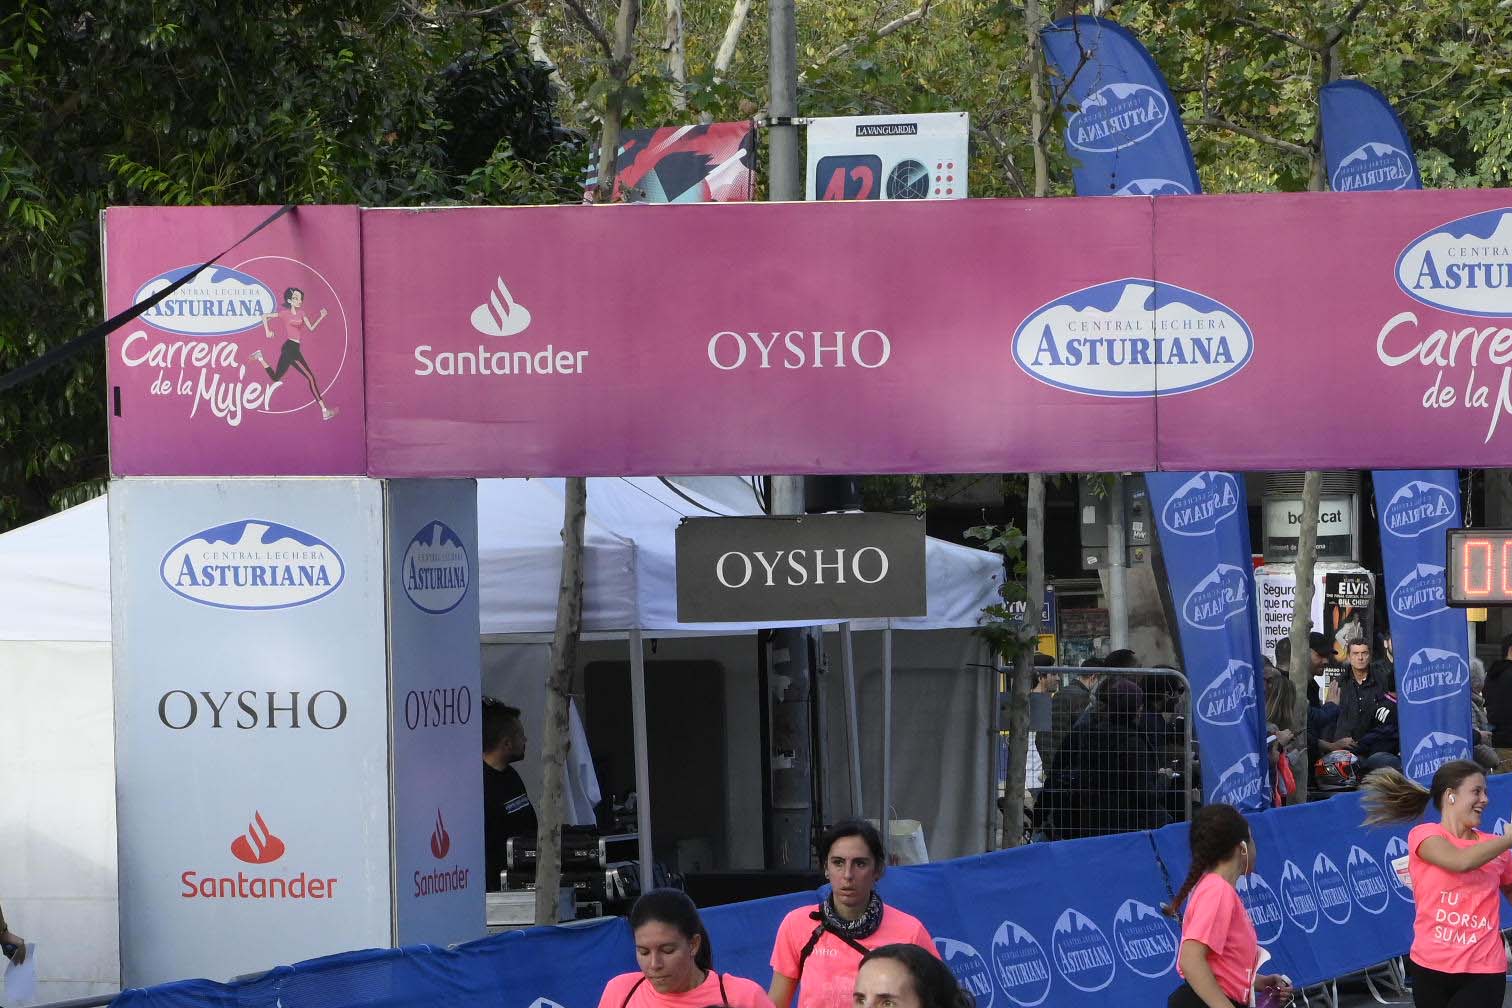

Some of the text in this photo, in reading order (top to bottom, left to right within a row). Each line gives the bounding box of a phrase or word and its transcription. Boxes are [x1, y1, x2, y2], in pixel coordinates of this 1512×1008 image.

[144, 290, 264, 317] ASTURIANA
[1069, 319, 1227, 331] CENTRAL LECHERA
[121, 331, 239, 368] Carrera
[415, 345, 589, 376] Santander
[707, 329, 891, 370] OYSHO
[1031, 324, 1235, 367] ASTURIANA
[150, 364, 283, 426] de la Mujer
[1422, 370, 1457, 409] de
[1464, 369, 1489, 409] la
[1288, 510, 1342, 525] b.cat
[175, 553, 331, 587] ASTURIANA
[203, 551, 325, 561] CENTRAL LECHERA
[716, 546, 889, 588] OYSHO
[407, 556, 466, 590] ASTURIANA
[1338, 582, 1369, 595] ELVIS
[1264, 600, 1279, 611] que
[158, 690, 347, 730] OYSHO
[405, 685, 472, 730] OYSHO
[181, 872, 338, 900] Santander
[413, 865, 470, 899] Santander
[1440, 891, 1459, 905] TU
[1435, 908, 1492, 930] DORSAL
[1434, 926, 1478, 945] SUMA
[1000, 956, 1048, 988] ASTURIANA
[1058, 944, 1112, 974] ASTURIANA
